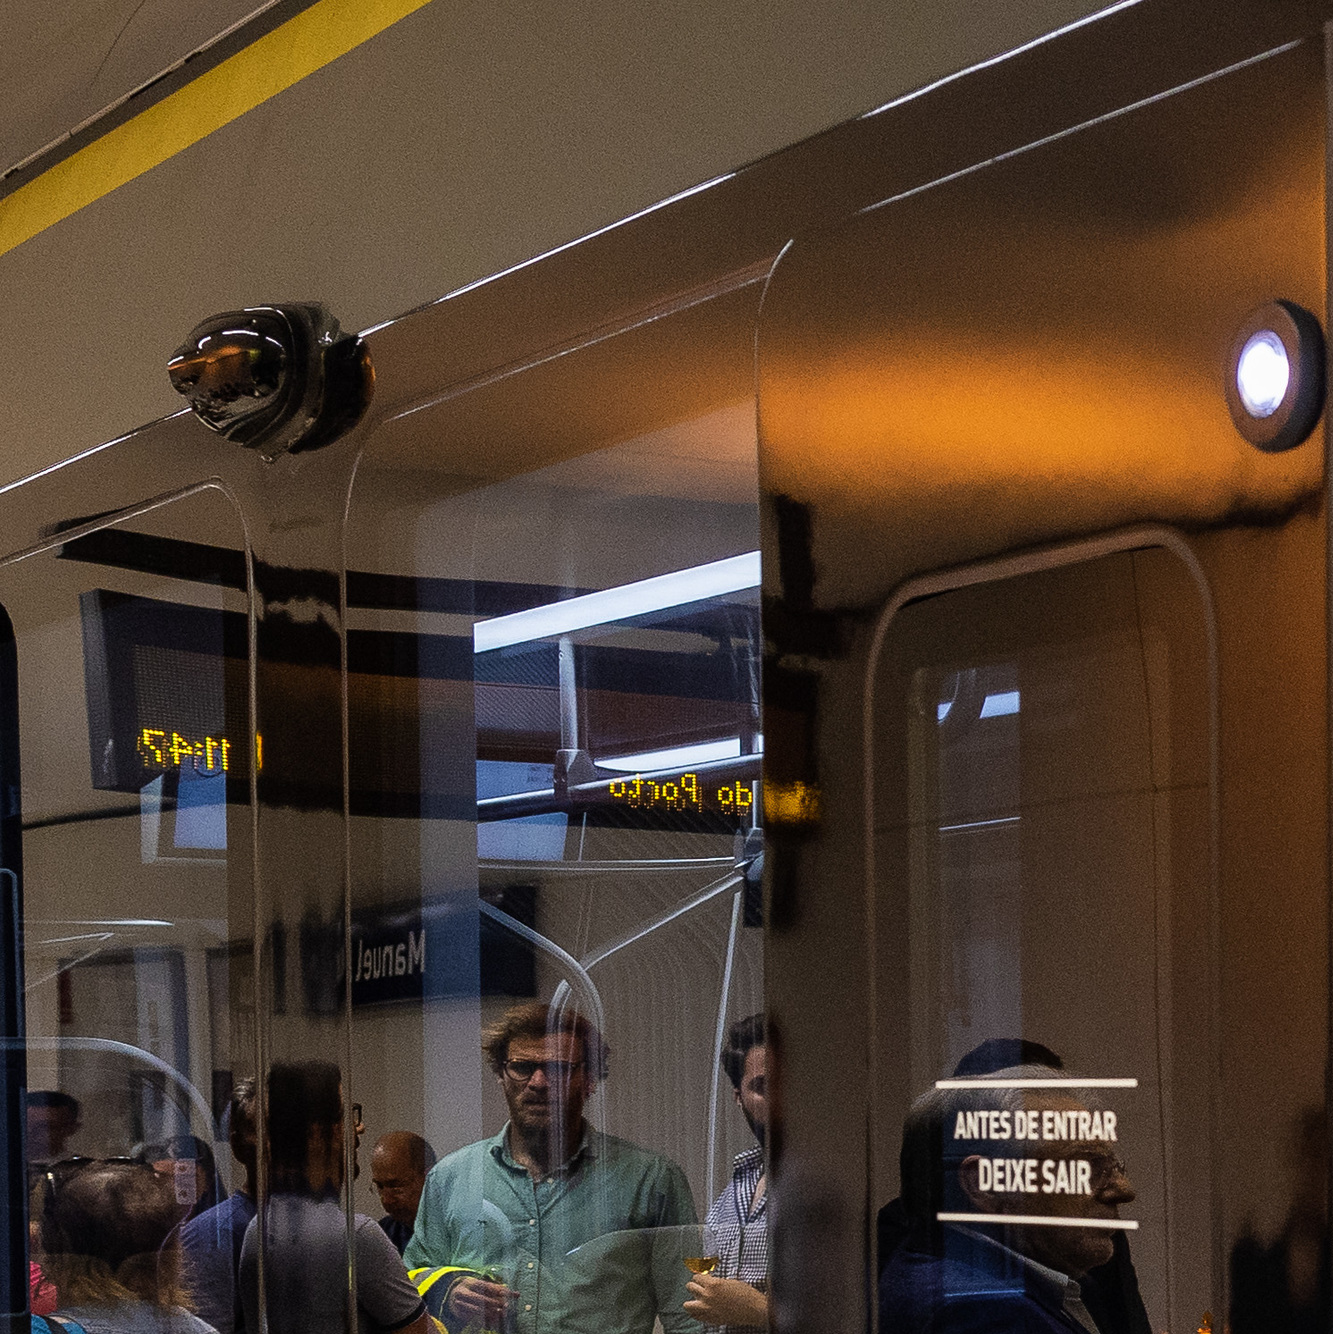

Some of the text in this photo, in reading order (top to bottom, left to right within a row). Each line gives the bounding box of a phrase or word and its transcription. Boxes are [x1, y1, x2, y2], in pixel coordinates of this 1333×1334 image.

[954, 1110, 1118, 1142] ANTES DE ENTRAR
[978, 1158, 1093, 1195] DEIXE SAIR
